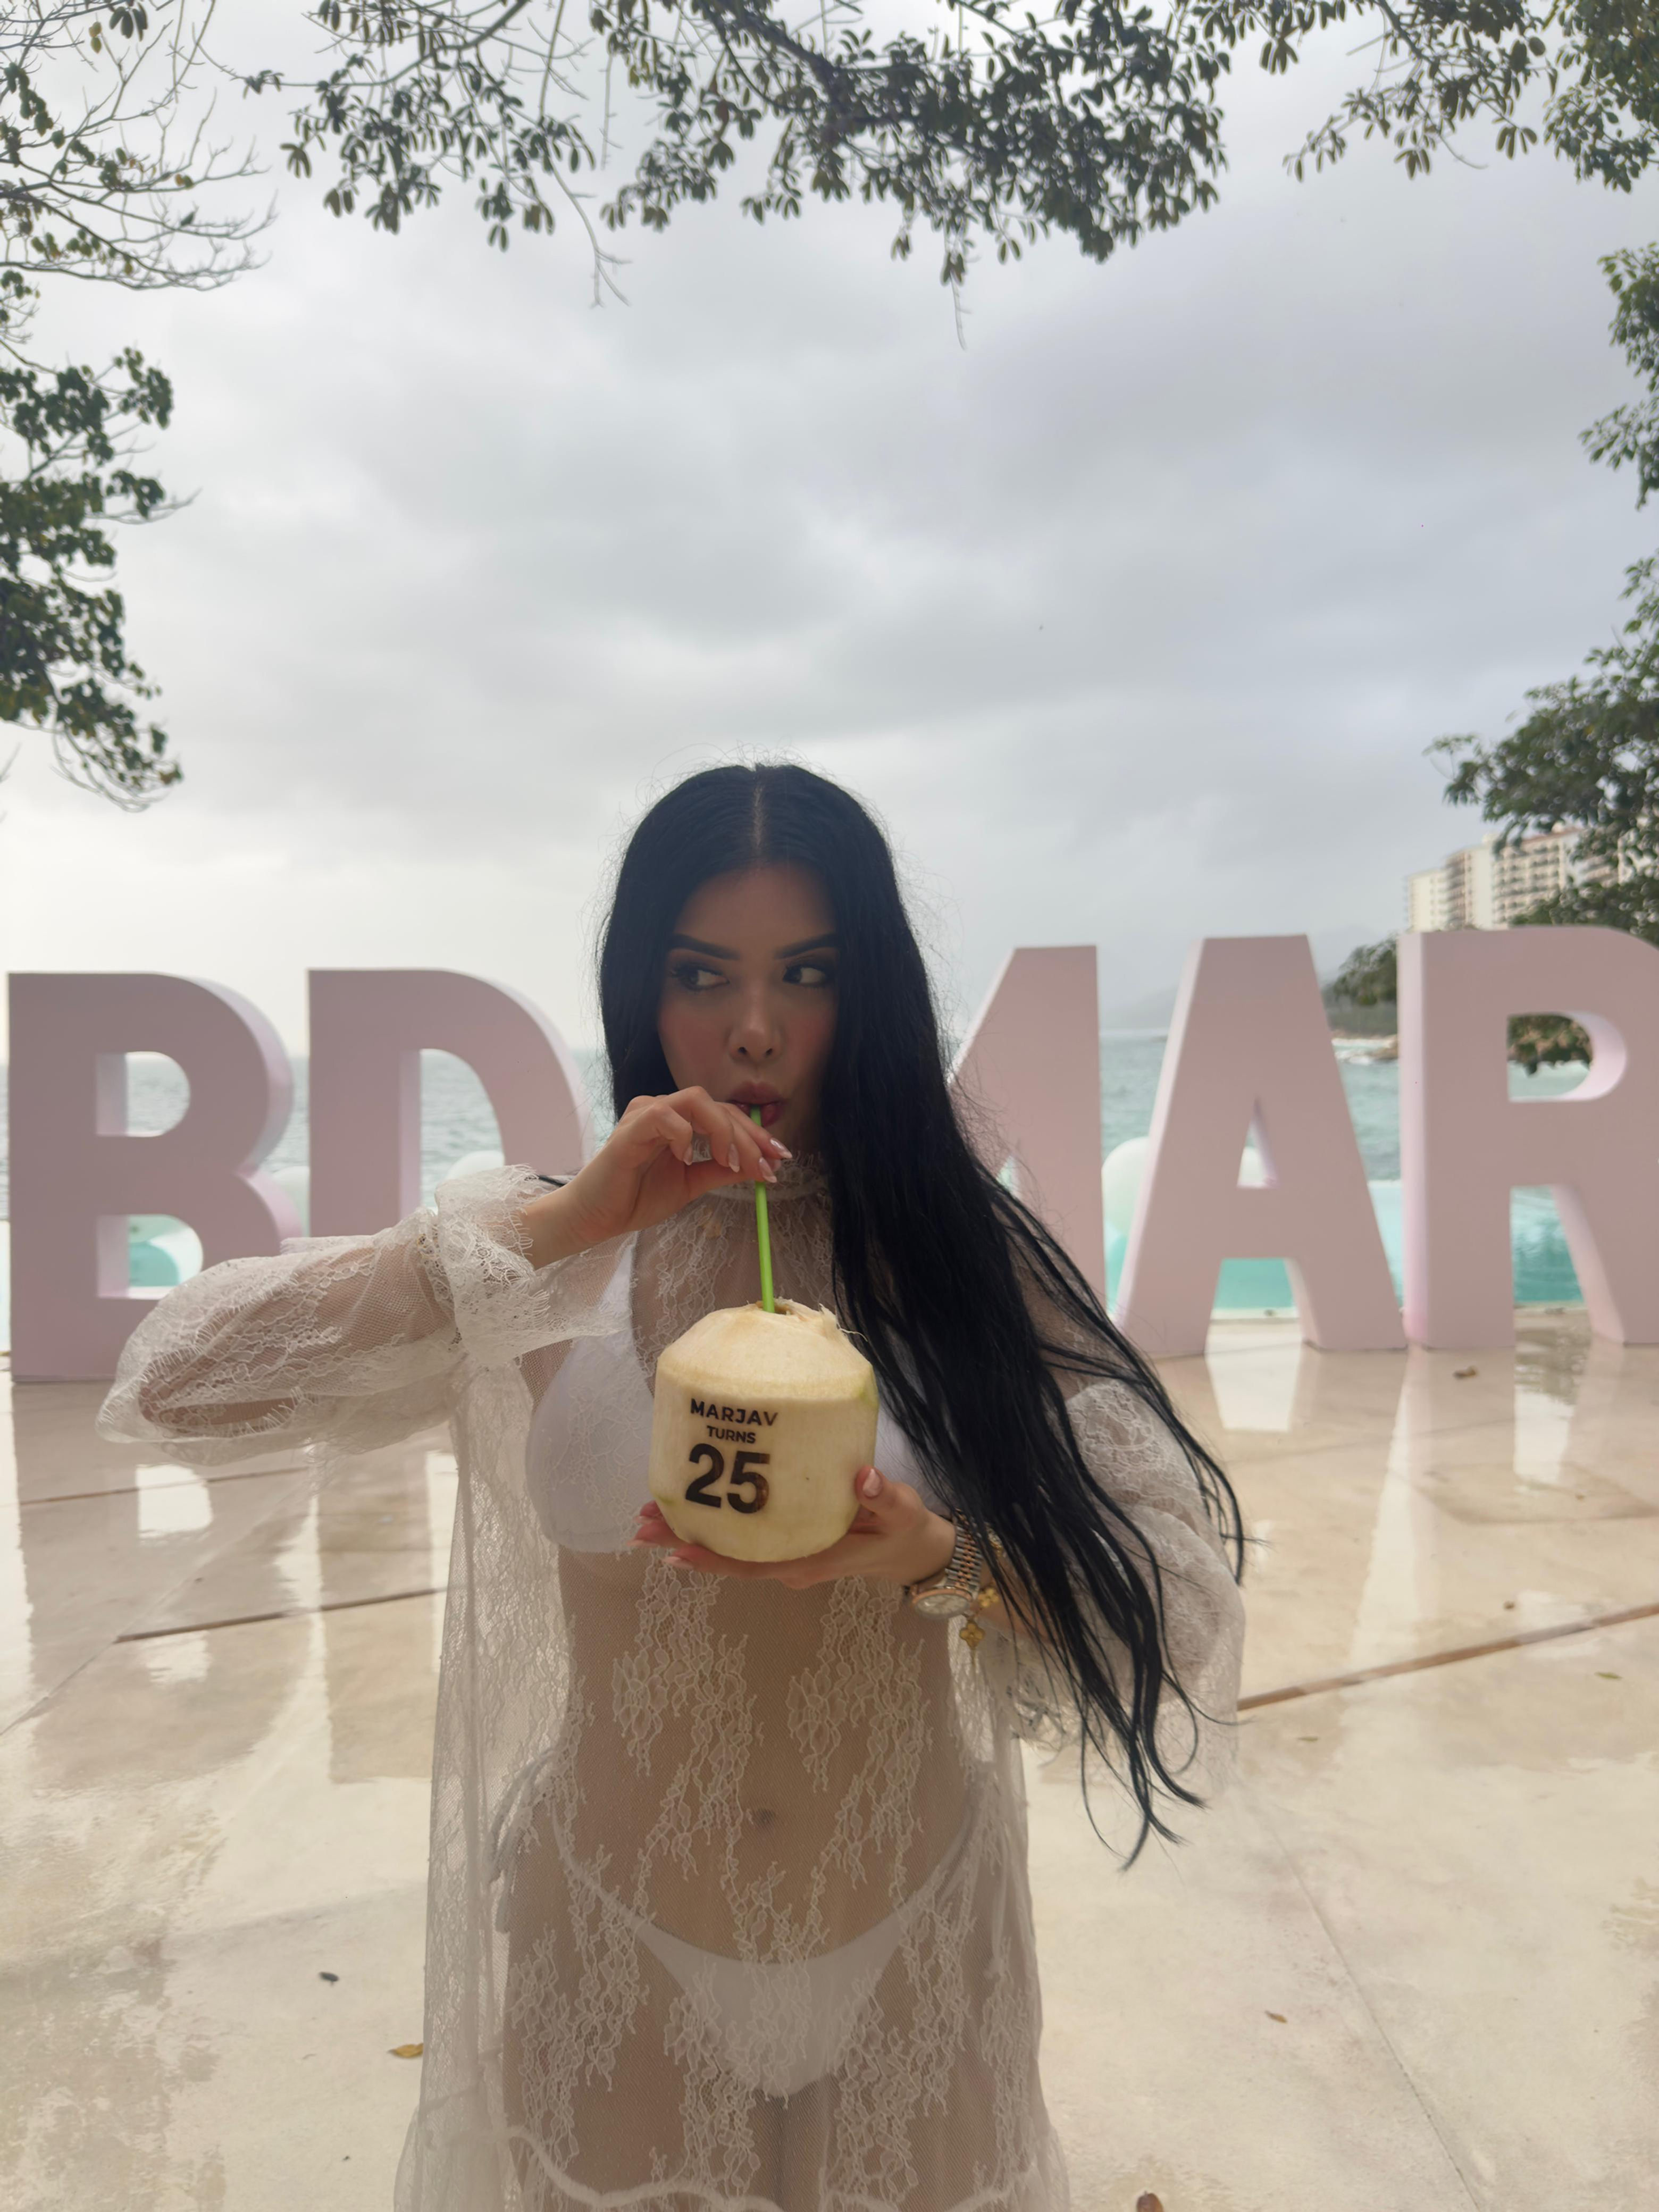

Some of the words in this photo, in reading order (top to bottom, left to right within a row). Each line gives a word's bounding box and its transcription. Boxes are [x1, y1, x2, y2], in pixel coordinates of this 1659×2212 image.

[690, 1398, 778, 1426] MARJAV
[707, 1425, 756, 1444] TURNS
[685, 1443, 770, 1514] 25
